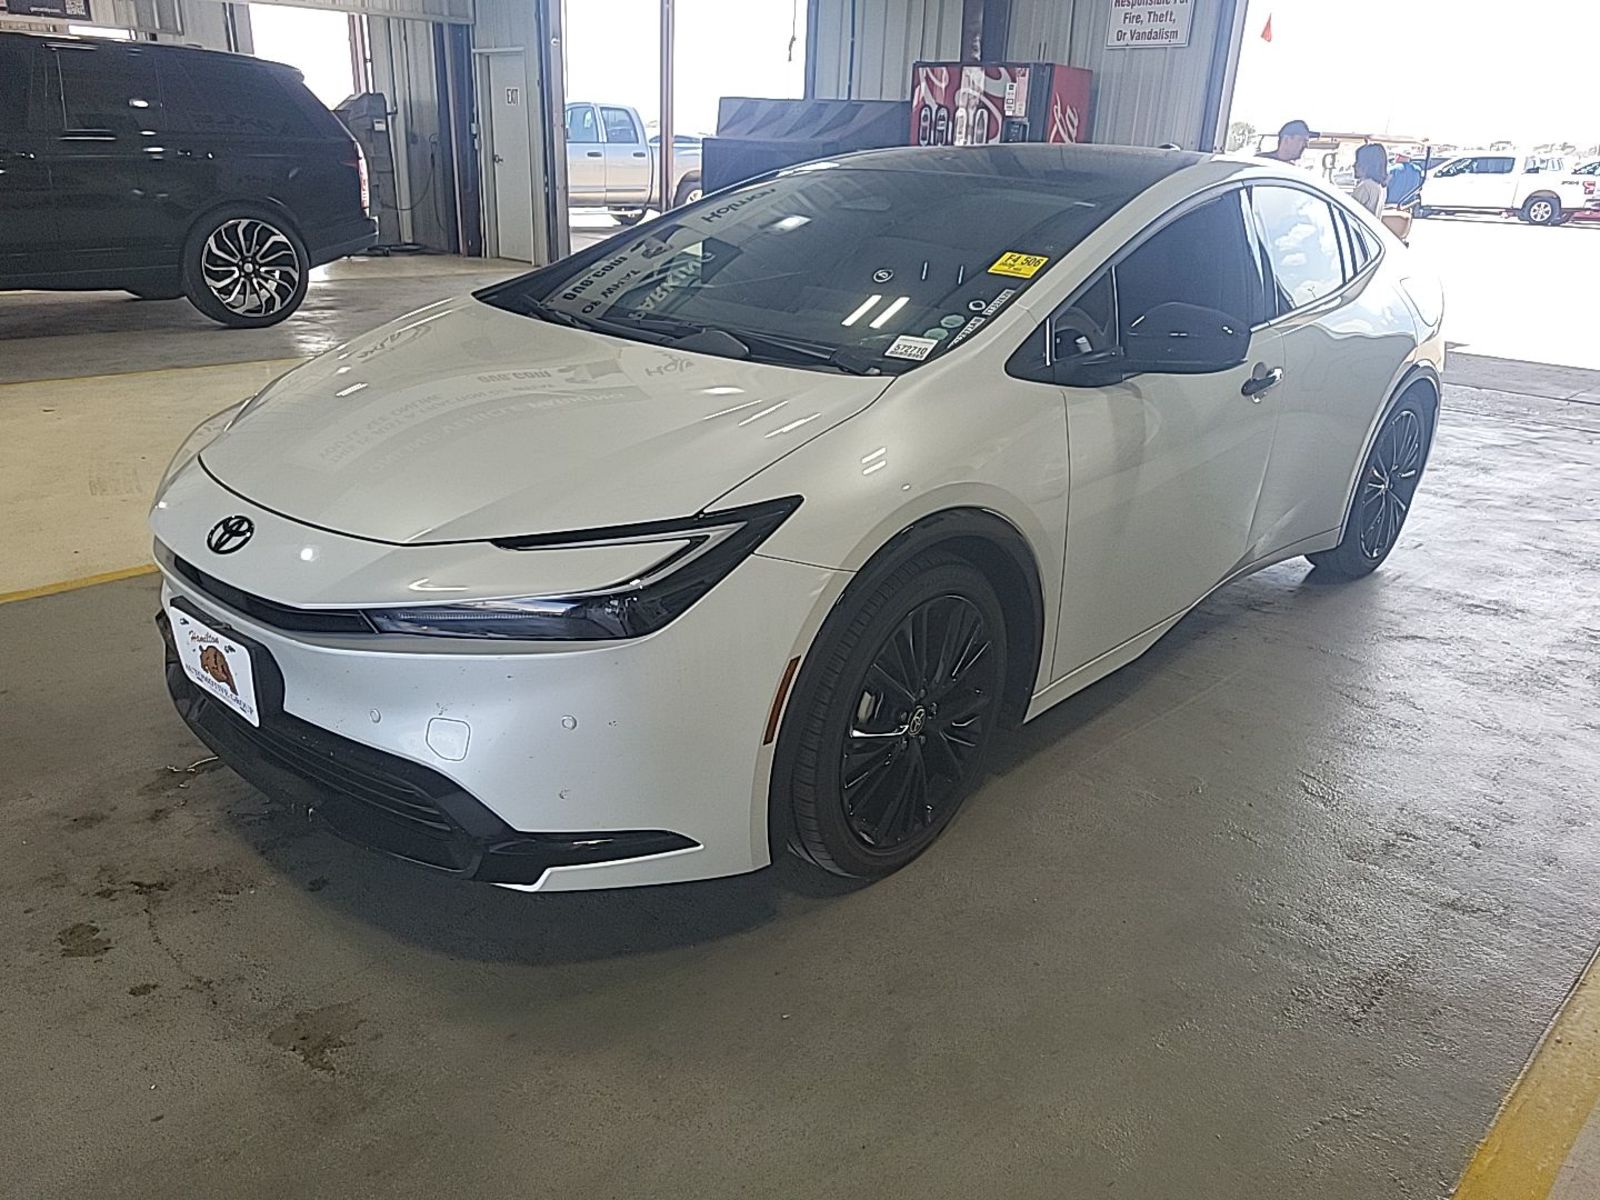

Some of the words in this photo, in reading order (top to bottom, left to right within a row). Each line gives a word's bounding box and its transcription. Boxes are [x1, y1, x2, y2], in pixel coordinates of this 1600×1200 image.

[1123, 12, 1144, 25] Fire,
[1147, 10, 1176, 24] Theft,
[1116, 30, 1127, 41] Or
[1130, 28, 1178, 41] Vandalism
[1021, 256, 1044, 268] 506
[894, 343, 929, 355] 572710
